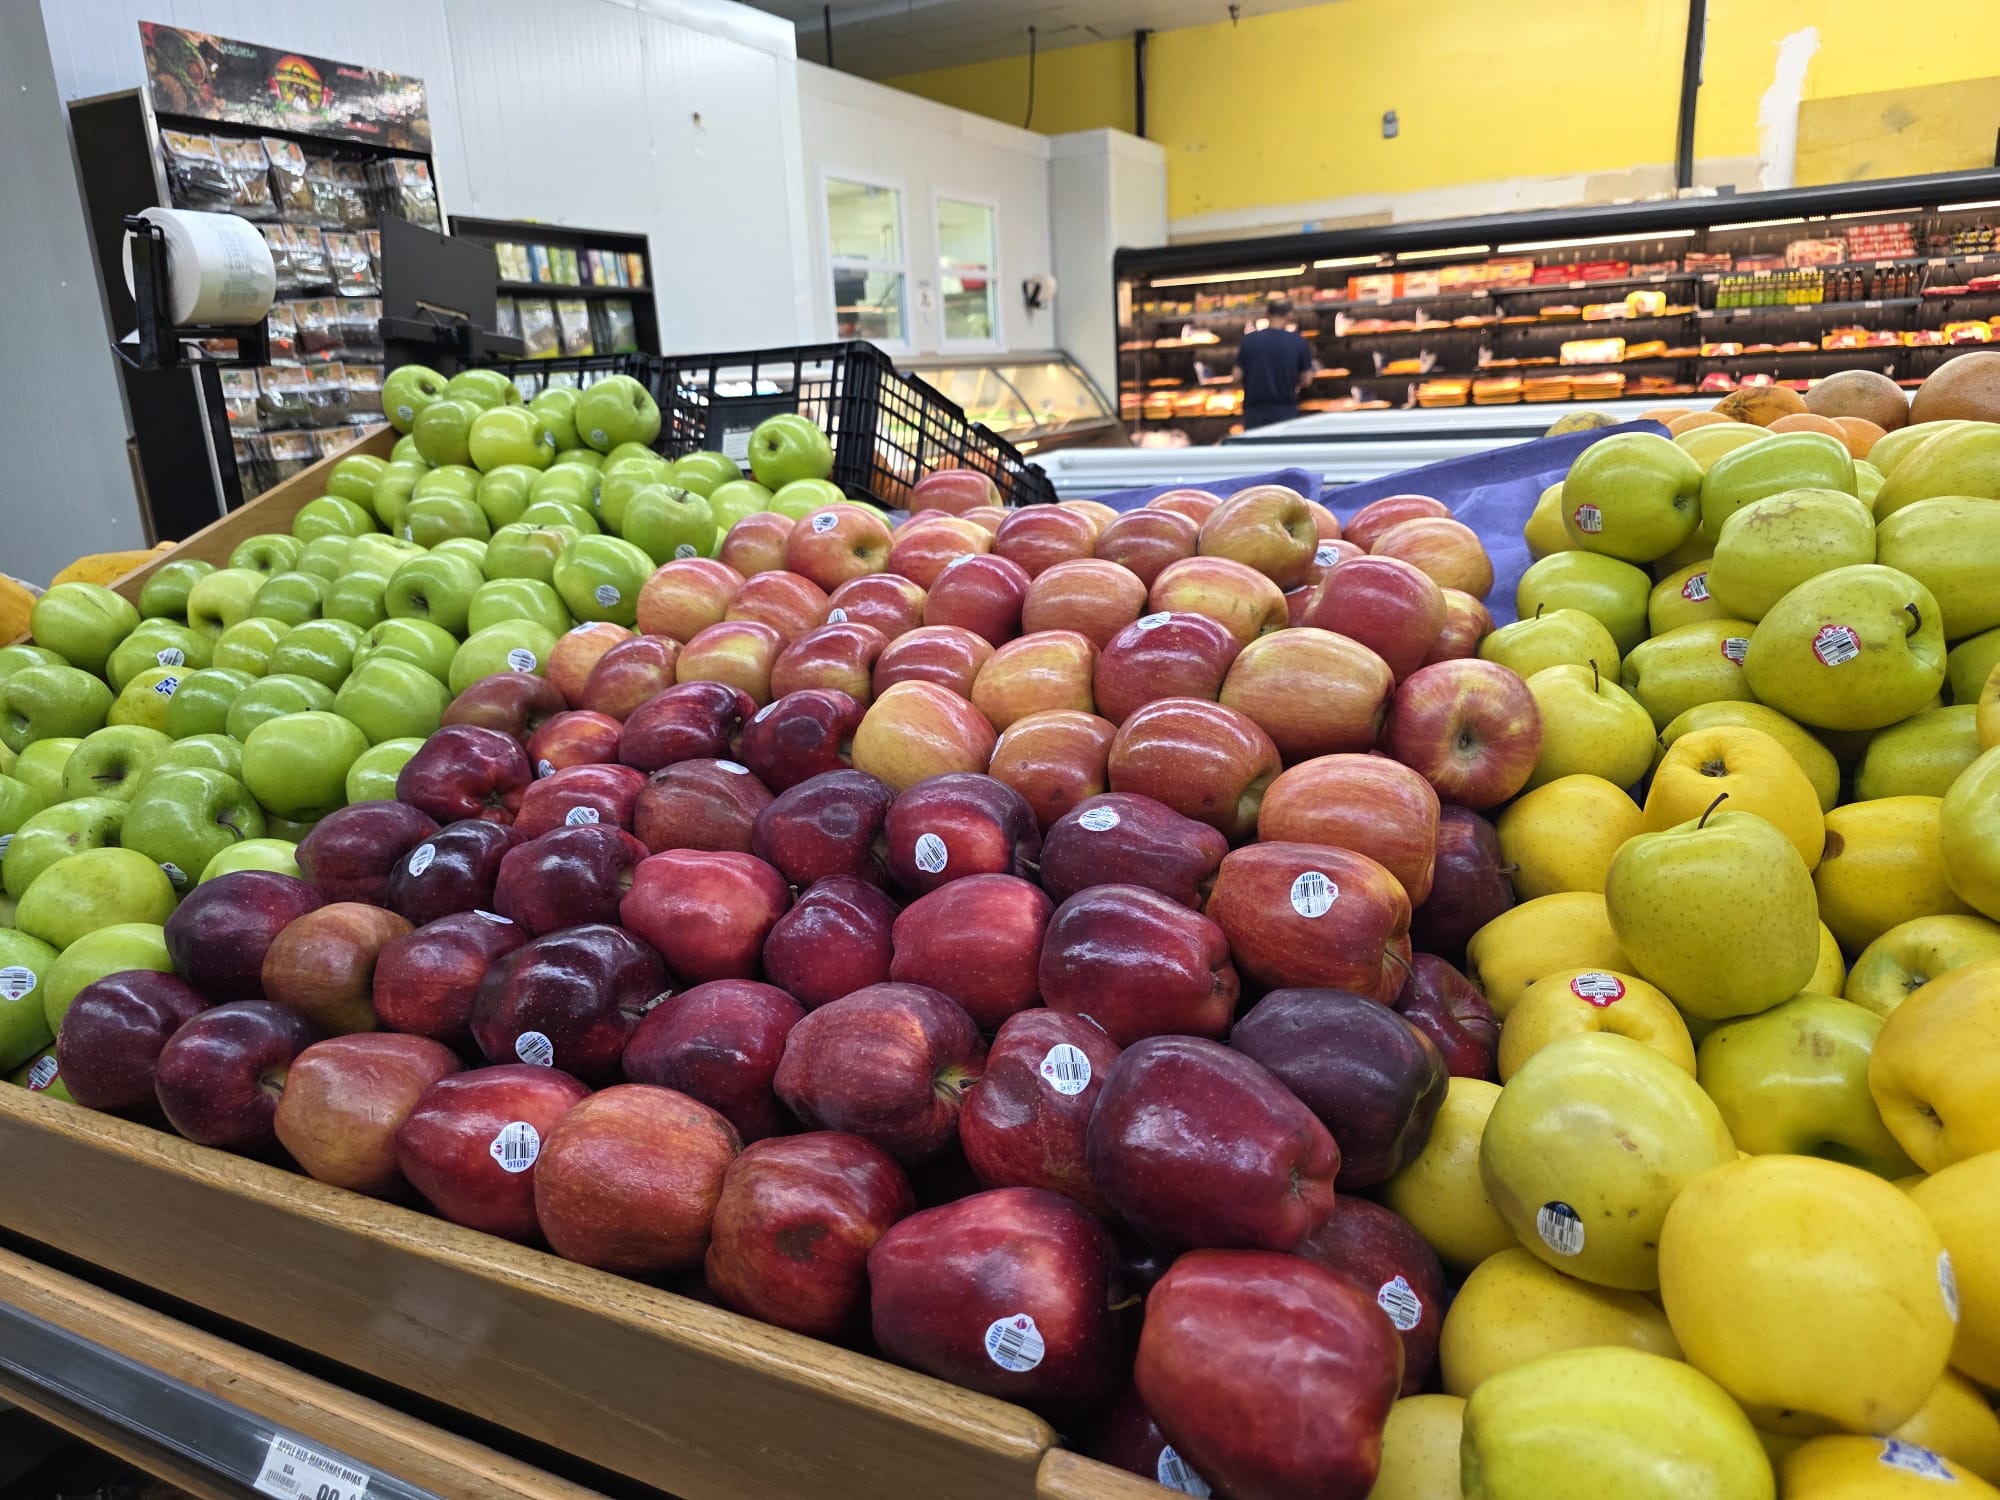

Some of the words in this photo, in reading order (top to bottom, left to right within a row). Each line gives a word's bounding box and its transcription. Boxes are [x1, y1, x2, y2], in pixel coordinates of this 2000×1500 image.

[507, 1159, 528, 1169] 4016
[988, 1324, 1004, 1350] 4016
[276, 1440, 295, 1457] APPLE
[341, 1469, 363, 1486] ROJAS
[283, 1463, 295, 1476] USA
